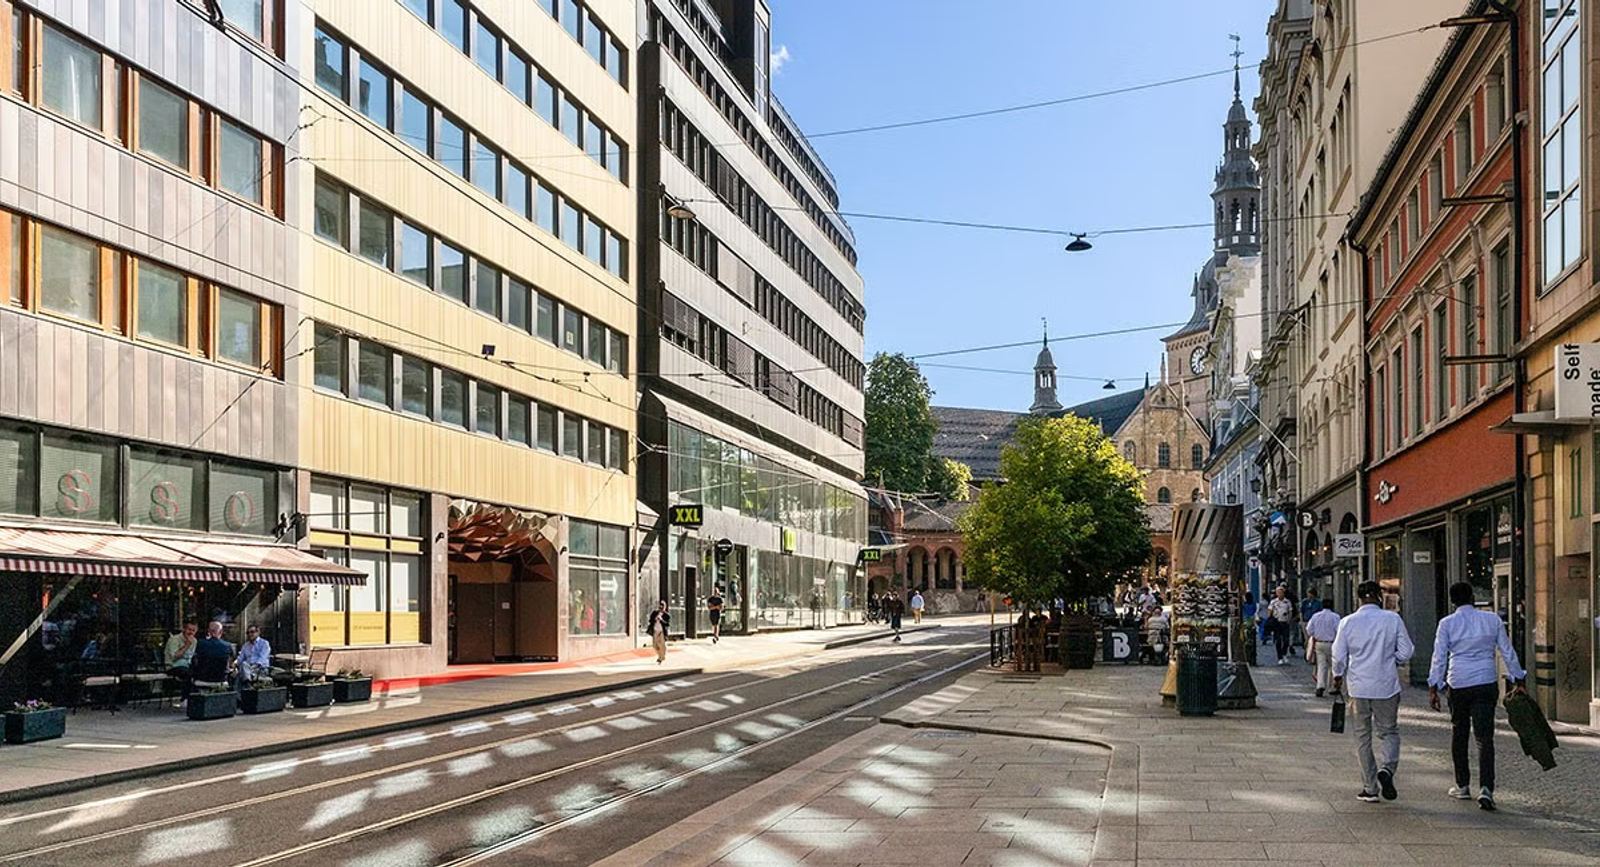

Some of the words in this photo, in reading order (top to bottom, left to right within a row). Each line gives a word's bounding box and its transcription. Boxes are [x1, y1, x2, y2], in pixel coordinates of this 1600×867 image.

[1564, 344, 1580, 380] Self
[1569, 447, 1583, 519] 11
[675, 508, 700, 522] XXL
[1302, 512, 1313, 527] B
[1338, 538, 1361, 549] Rita
[863, 551, 879, 560] XXL
[1111, 632, 1131, 658] B
